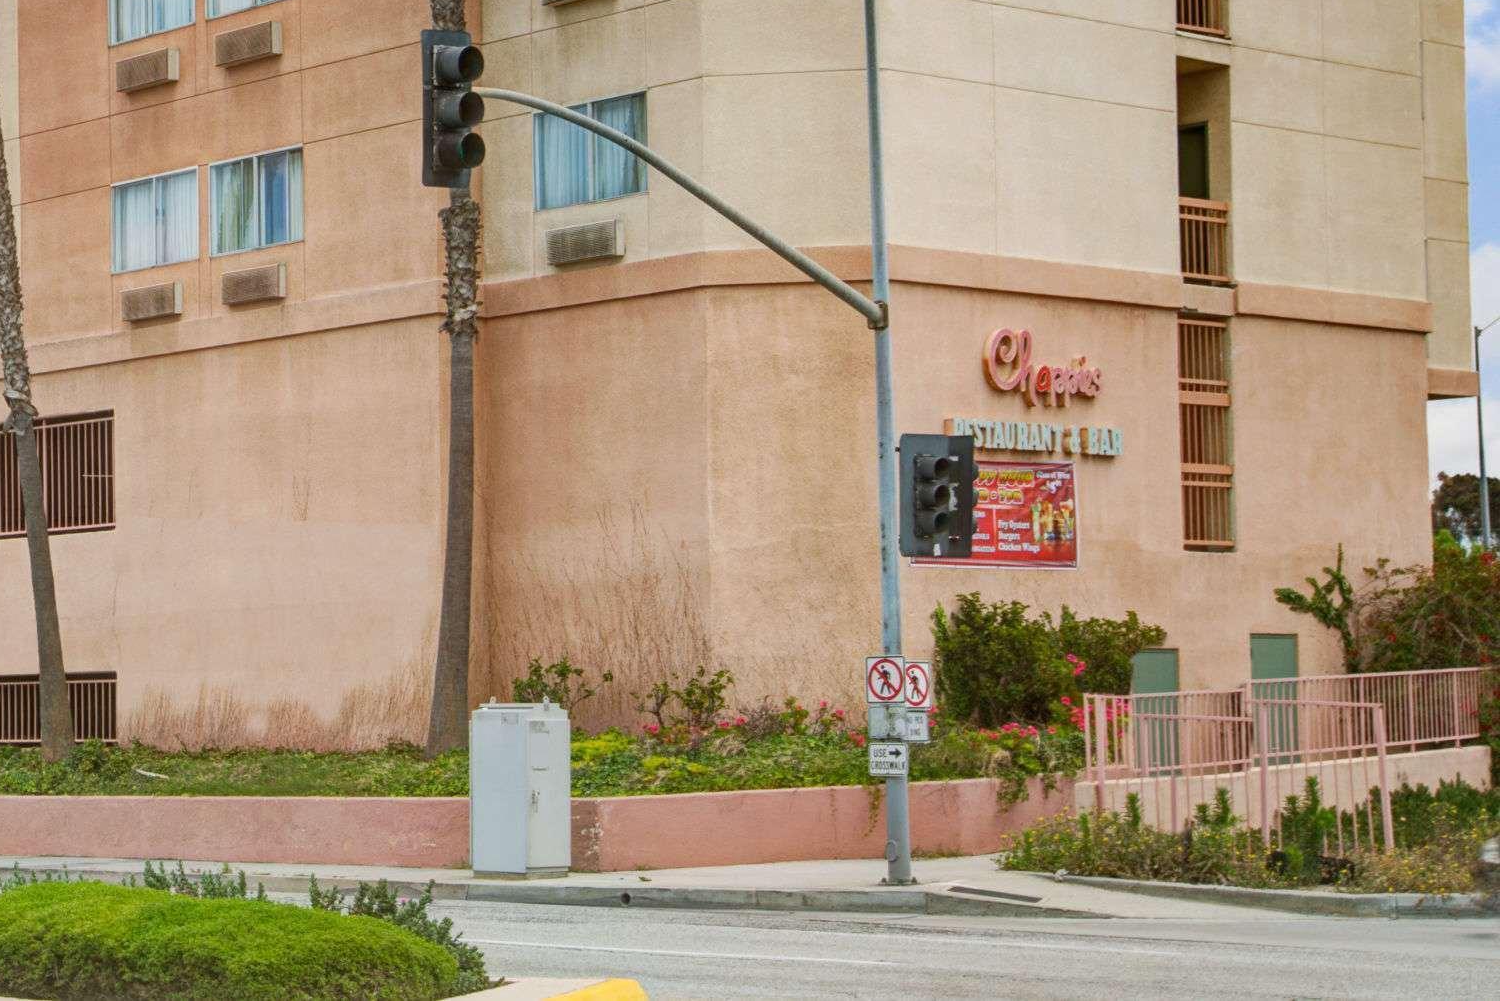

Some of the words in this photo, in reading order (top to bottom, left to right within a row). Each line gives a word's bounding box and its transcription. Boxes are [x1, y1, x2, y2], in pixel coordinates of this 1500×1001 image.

[1069, 425, 1082, 454] &
[1087, 426, 1124, 456] BAR
[873, 748, 887, 758] USE
